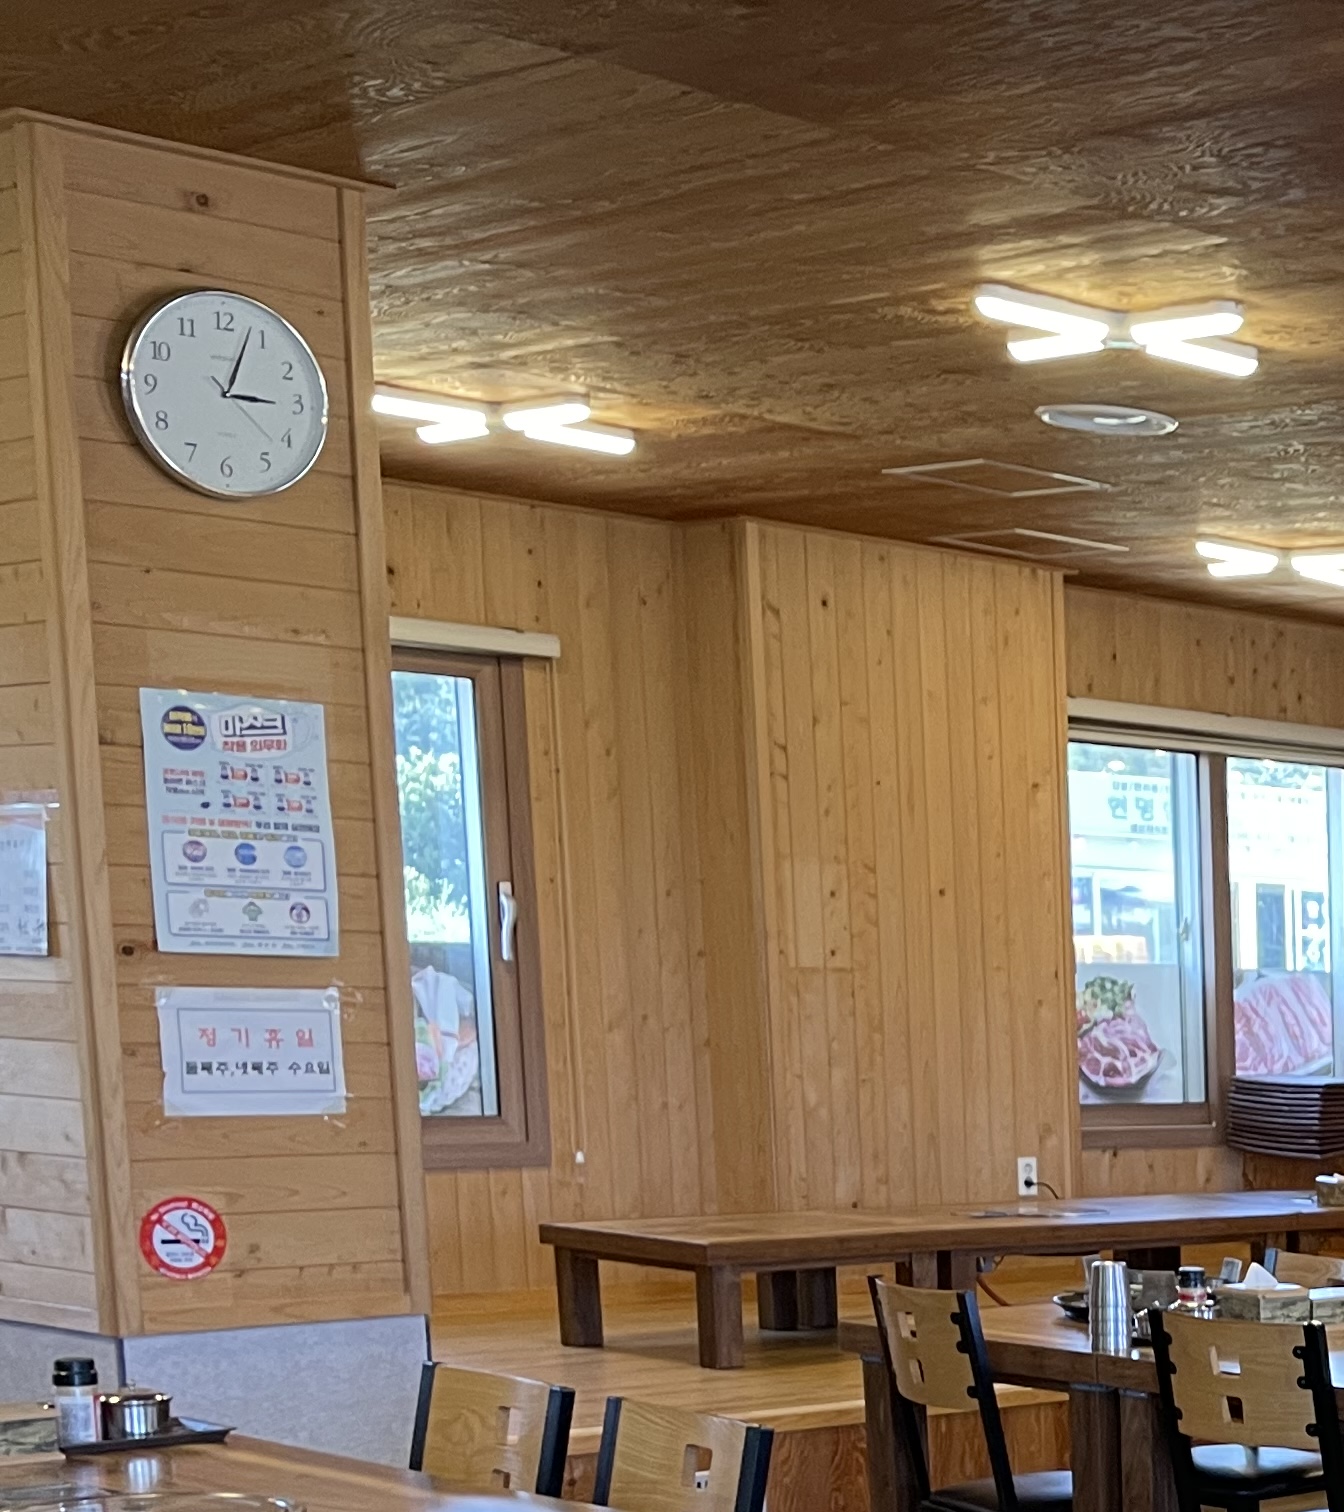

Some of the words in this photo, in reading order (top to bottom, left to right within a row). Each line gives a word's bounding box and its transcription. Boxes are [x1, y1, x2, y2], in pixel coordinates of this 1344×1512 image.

[178, 317, 196, 337] 11
[214, 311, 234, 332] 12
[258, 330, 266, 349] 1
[150, 341, 170, 361] 10
[282, 362, 293, 380] 2
[144, 374, 157, 395] 9
[292, 394, 303, 415] 3
[155, 411, 168, 430] 8
[281, 428, 292, 448] 4
[184, 442, 197, 462] 7
[221, 456, 233, 477] 6
[260, 452, 271, 473] 5
[220, 714, 286, 736] 마스크
[222, 740, 246, 752] 착용
[250, 739, 286, 751] 의무화
[198, 1027, 314, 1049] 정기휴일
[186, 1061, 278, 1076] 둘째주,넷째주
[288, 1061, 330, 1075] 수요일
